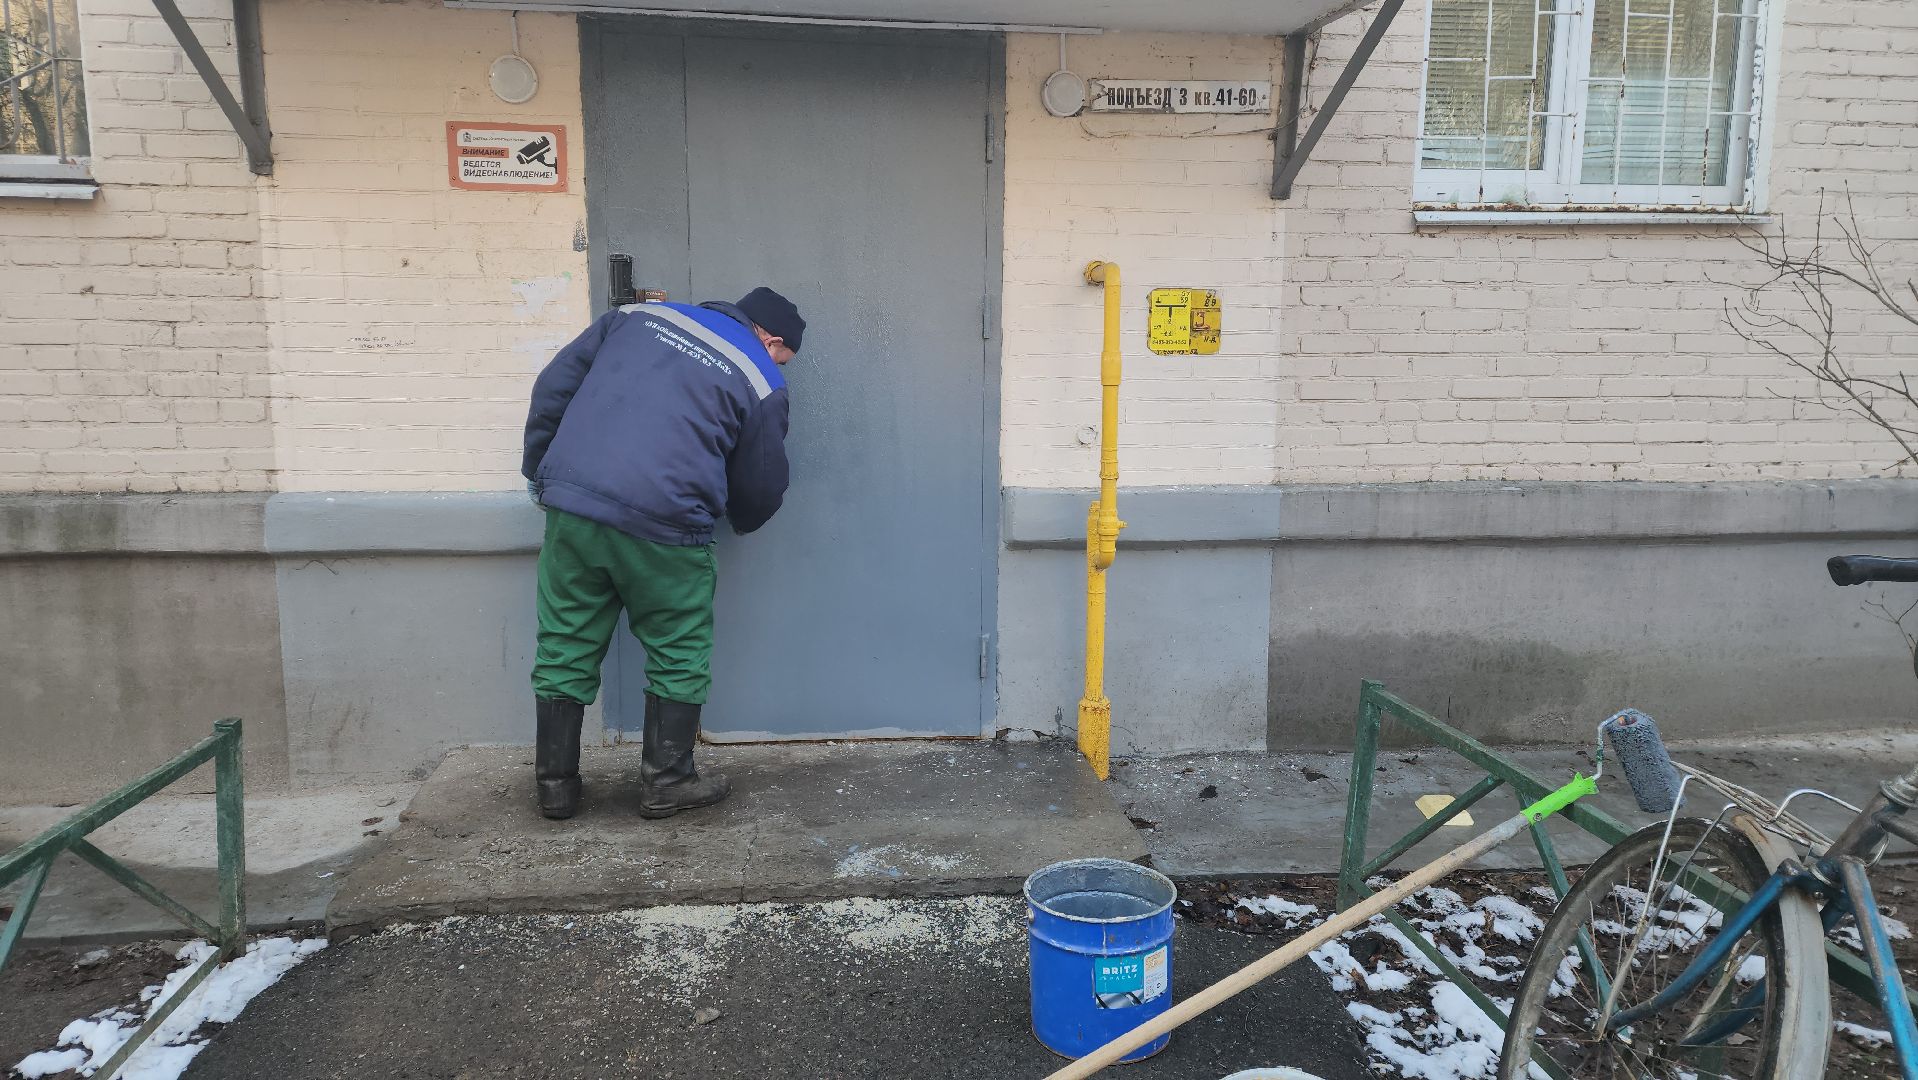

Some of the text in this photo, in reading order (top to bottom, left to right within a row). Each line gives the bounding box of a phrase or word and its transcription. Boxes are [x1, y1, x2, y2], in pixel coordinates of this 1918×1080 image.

[1179, 87, 1188, 106] 3
[462, 148, 505, 157] ВНИМАНИЕ
[463, 169, 553, 179] ВИДЕОНАБЛЮДЕНИЕ!
[1102, 964, 1138, 975] BRITZ
